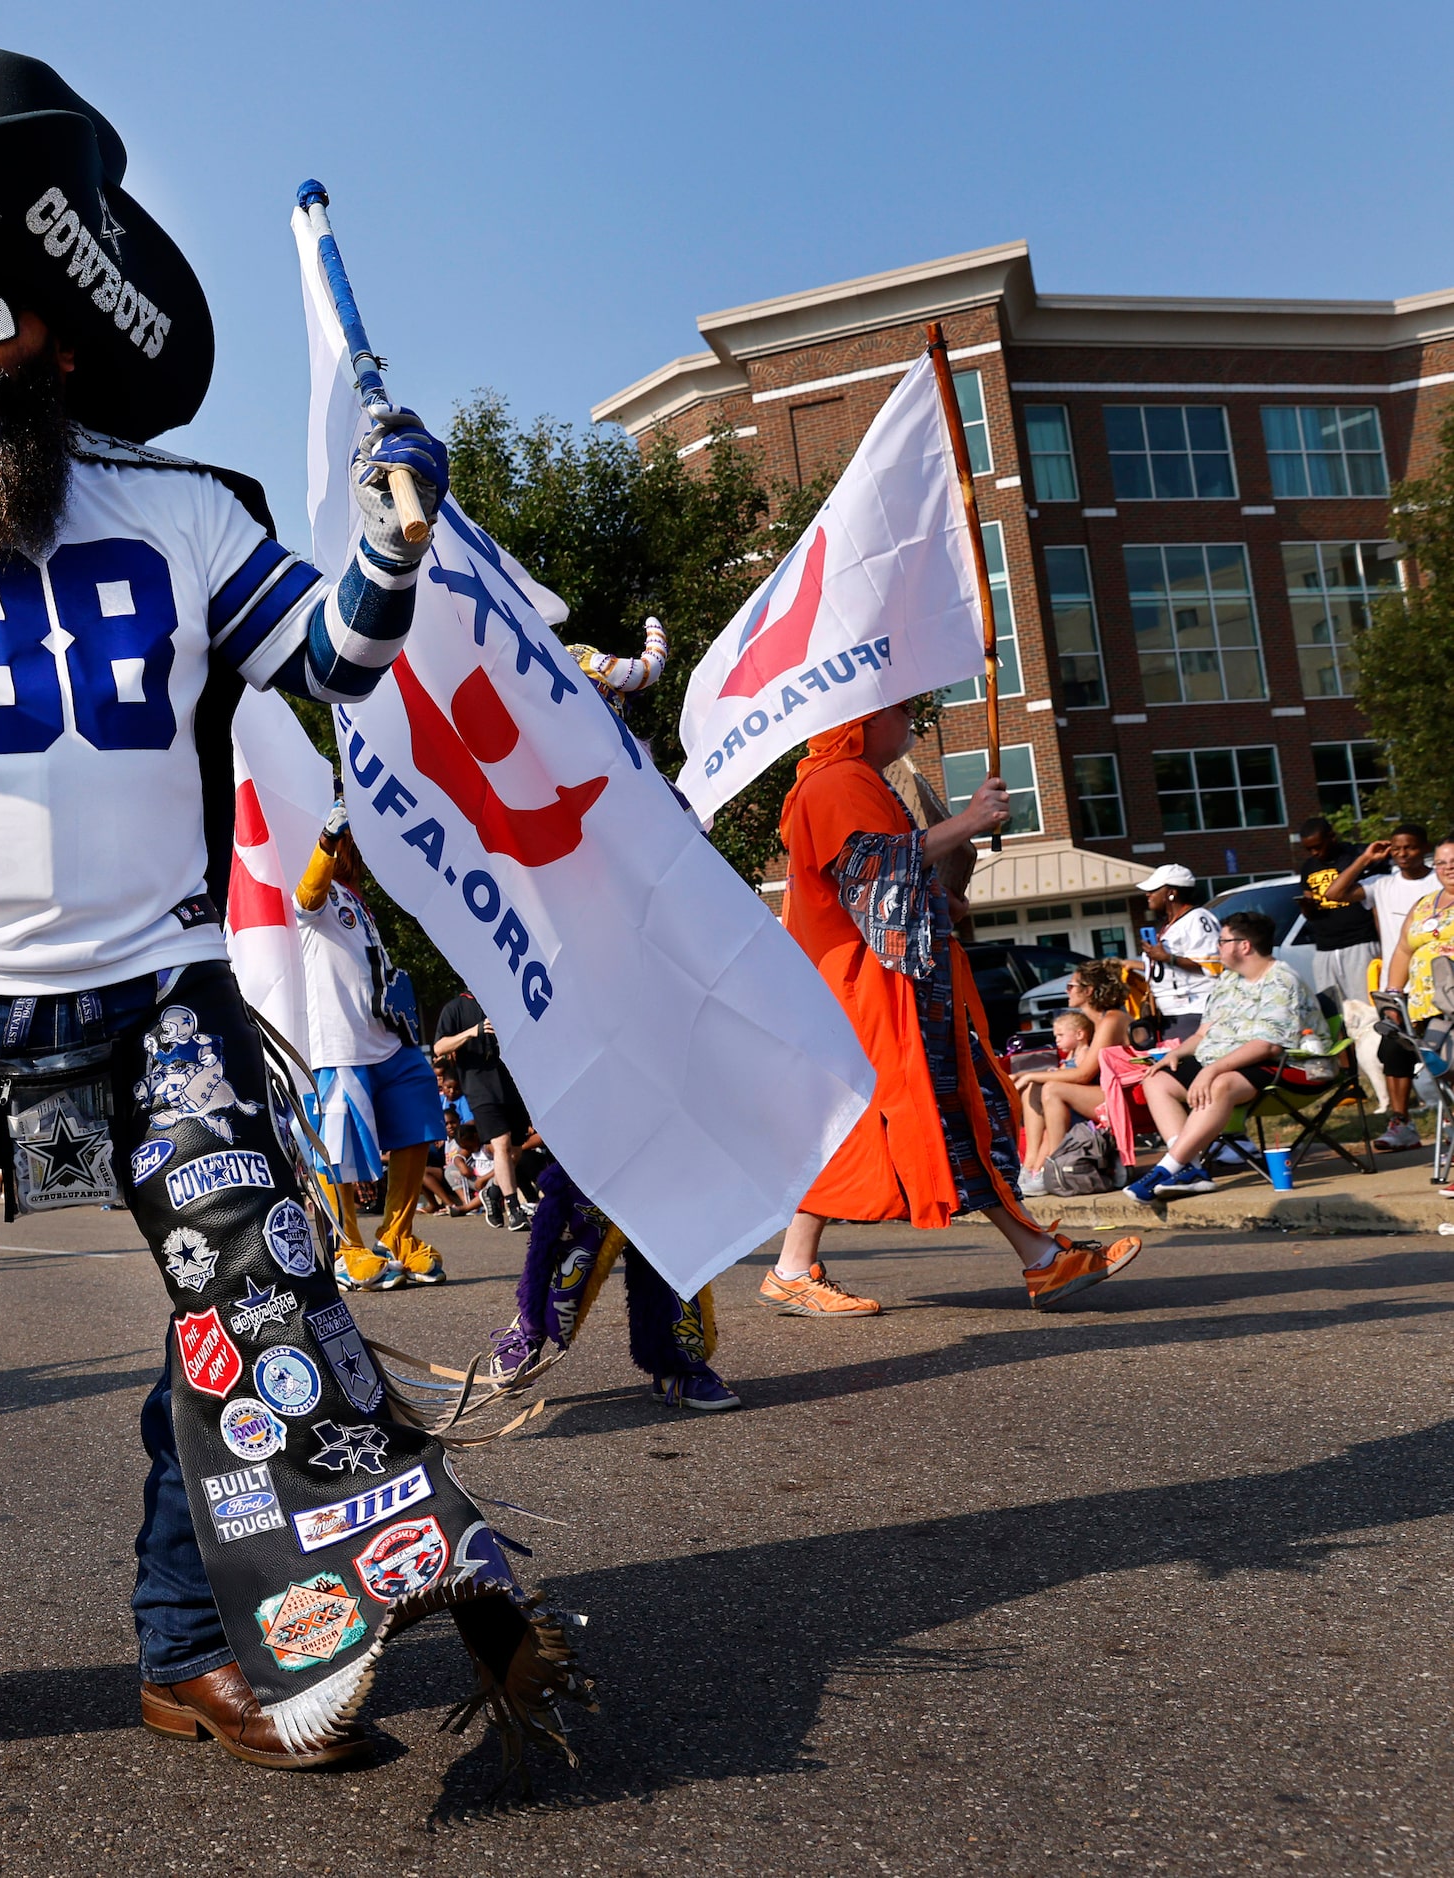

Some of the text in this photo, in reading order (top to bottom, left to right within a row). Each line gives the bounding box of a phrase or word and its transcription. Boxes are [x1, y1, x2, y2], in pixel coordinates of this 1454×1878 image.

[26, 186, 172, 359] COWBOYS
[868, 880, 878, 919] BRONCOS
[900, 887, 909, 926] BRONCOS
[22, 998, 35, 1019] 1960
[132, 1147, 161, 1179] Ford
[178, 1268, 214, 1286] COWBOYS
[231, 1291, 298, 1334] COWBOYS
[316, 1304, 346, 1326] DALLAS
[185, 1323, 200, 1345] THE
[318, 1313, 352, 1337] COWBOYS
[187, 1323, 220, 1378] SALVATION
[262, 1349, 290, 1364] DALLAS
[208, 1346, 230, 1385] ARMY
[281, 1395, 315, 1413] COWBOYS
[204, 1467, 268, 1500] BUILT
[226, 1494, 263, 1514] Ford
[218, 1509, 283, 1540] TOUGH
[374, 1535, 392, 1558] SUPER
[301, 1630, 339, 1652] ARIZONA
